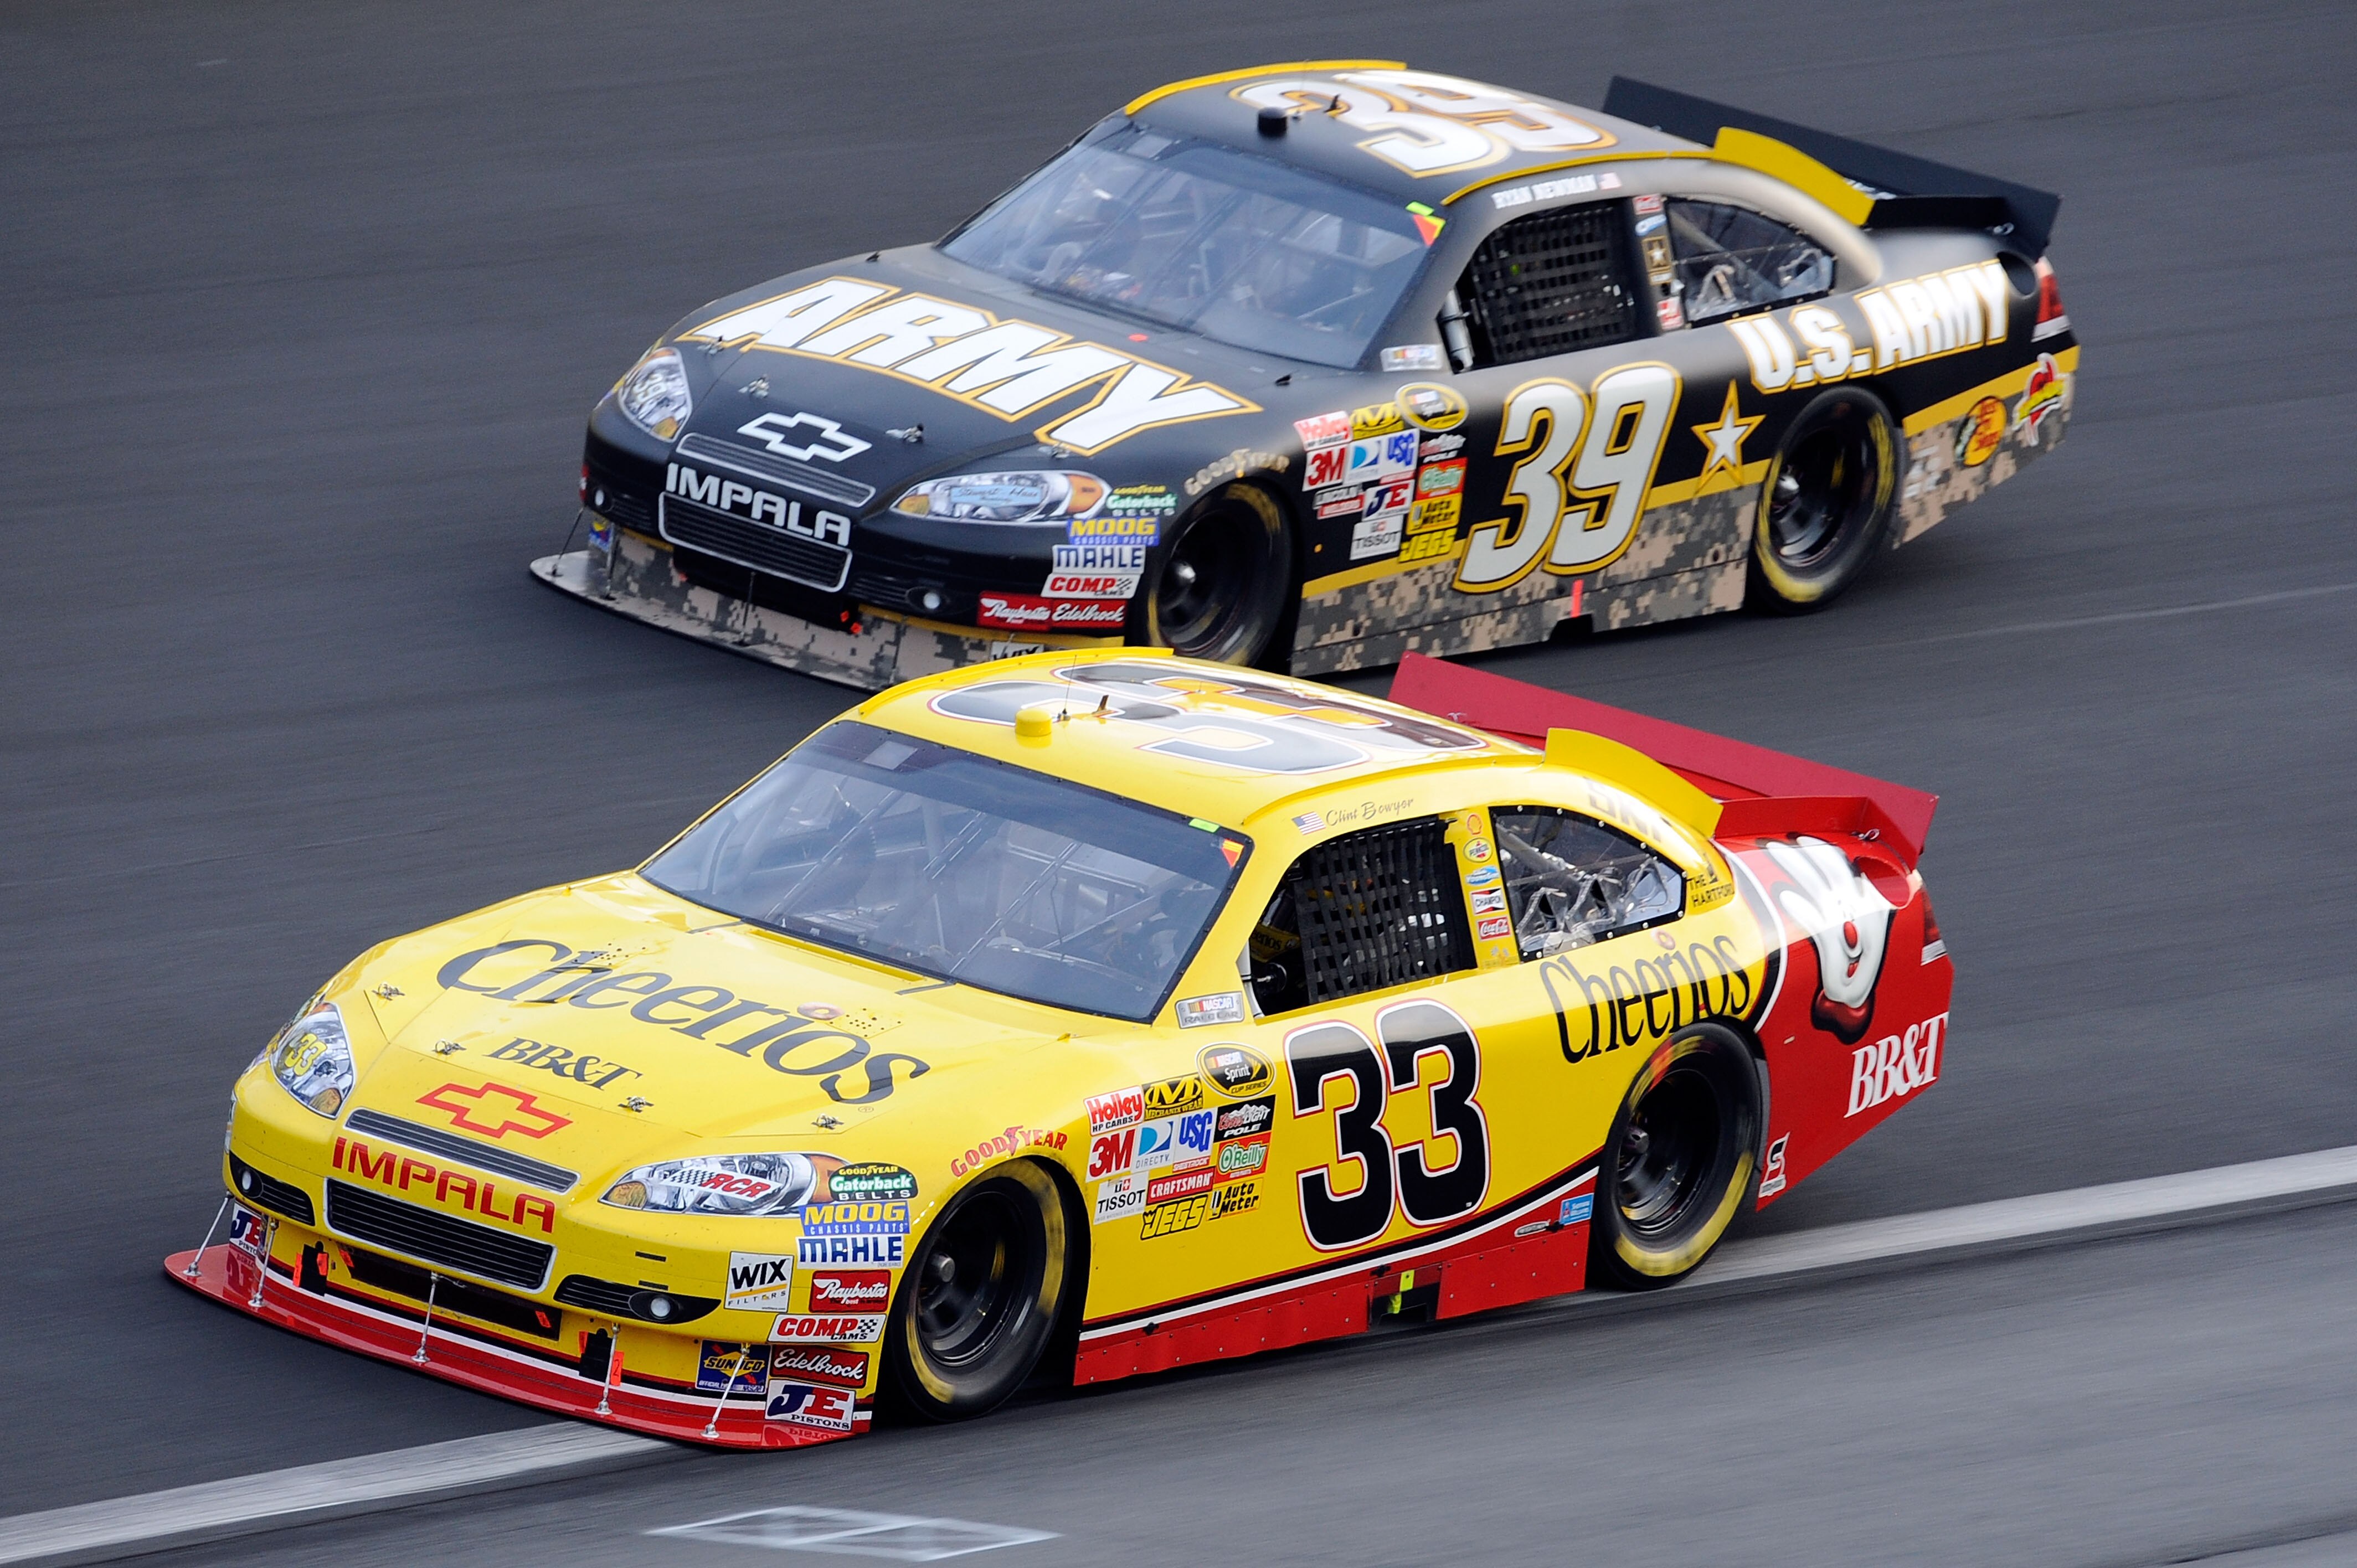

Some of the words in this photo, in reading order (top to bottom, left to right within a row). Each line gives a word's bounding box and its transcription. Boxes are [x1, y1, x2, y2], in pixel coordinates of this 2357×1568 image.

[1725, 304, 1875, 395] U.S.
[1854, 259, 2010, 375] ARMY
[673, 275, 1265, 457] ARMY
[1387, 432, 1414, 466] USG
[1308, 447, 1347, 486] 3M
[1452, 360, 1683, 595] 39
[665, 461, 851, 548] IMPALA
[1366, 483, 1410, 518] JE
[1069, 519, 1157, 536] MOOG
[1352, 530, 1399, 550] TISSOT
[1056, 547, 1143, 568] MAHLE
[1397, 527, 1458, 564] JEGS
[1050, 577, 1116, 592] COMP
[1326, 809, 1358, 827] Clint
[1361, 797, 1414, 821] Bowyer
[1686, 874, 1706, 891] THE
[1691, 883, 1735, 908] HARTFORD
[1539, 935, 1750, 1064] Cheerios
[436, 938, 930, 1105] Cheerios
[284, 1033, 328, 1077] 33
[482, 1036, 644, 1091] BB&T
[1843, 1011, 1950, 1118] BB&T
[1224, 1064, 1251, 1083] Sprint
[1231, 1086, 1244, 1095] CUP
[1087, 1093, 1143, 1125] Holley
[1181, 1100, 1203, 1114] WEAR
[1092, 1121, 1104, 1133] HP
[1105, 1115, 1134, 1129] CARBS
[1179, 1111, 1213, 1153] USG
[1223, 1123, 1262, 1138] POLE
[1283, 997, 1492, 1254] 33
[950, 1125, 1068, 1178] GOODYEAR
[1089, 1128, 1136, 1178] 3M
[1135, 1153, 1170, 1169] DIRECTV
[1220, 1144, 1267, 1171] O'Reilly
[830, 1173, 913, 1193] Gatorback
[838, 1165, 899, 1176] GOODYEAR
[332, 1136, 557, 1234] IMPALA
[701, 1173, 774, 1198] RCR
[838, 1189, 911, 1201] BELTS
[1150, 1171, 1213, 1198] CRAFTSMAN
[1223, 1183, 1255, 1200] Auto
[804, 1201, 907, 1226] MOOG
[1098, 1189, 1146, 1214] TISSOT
[1219, 1195, 1259, 1214] Meter
[810, 1223, 861, 1235] CHASSIS
[869, 1223, 904, 1234] PARTS
[1140, 1194, 1209, 1241] JEGS
[238, 1240, 258, 1256] PISTO
[798, 1236, 902, 1263] MAHLE
[731, 1258, 787, 1290] WIX
[776, 1317, 860, 1338] COMP
[830, 1332, 869, 1341] CAMS
[774, 1348, 864, 1380] Edelbrock
[766, 1384, 850, 1420] JE
[790, 1414, 850, 1431] PISTONS
